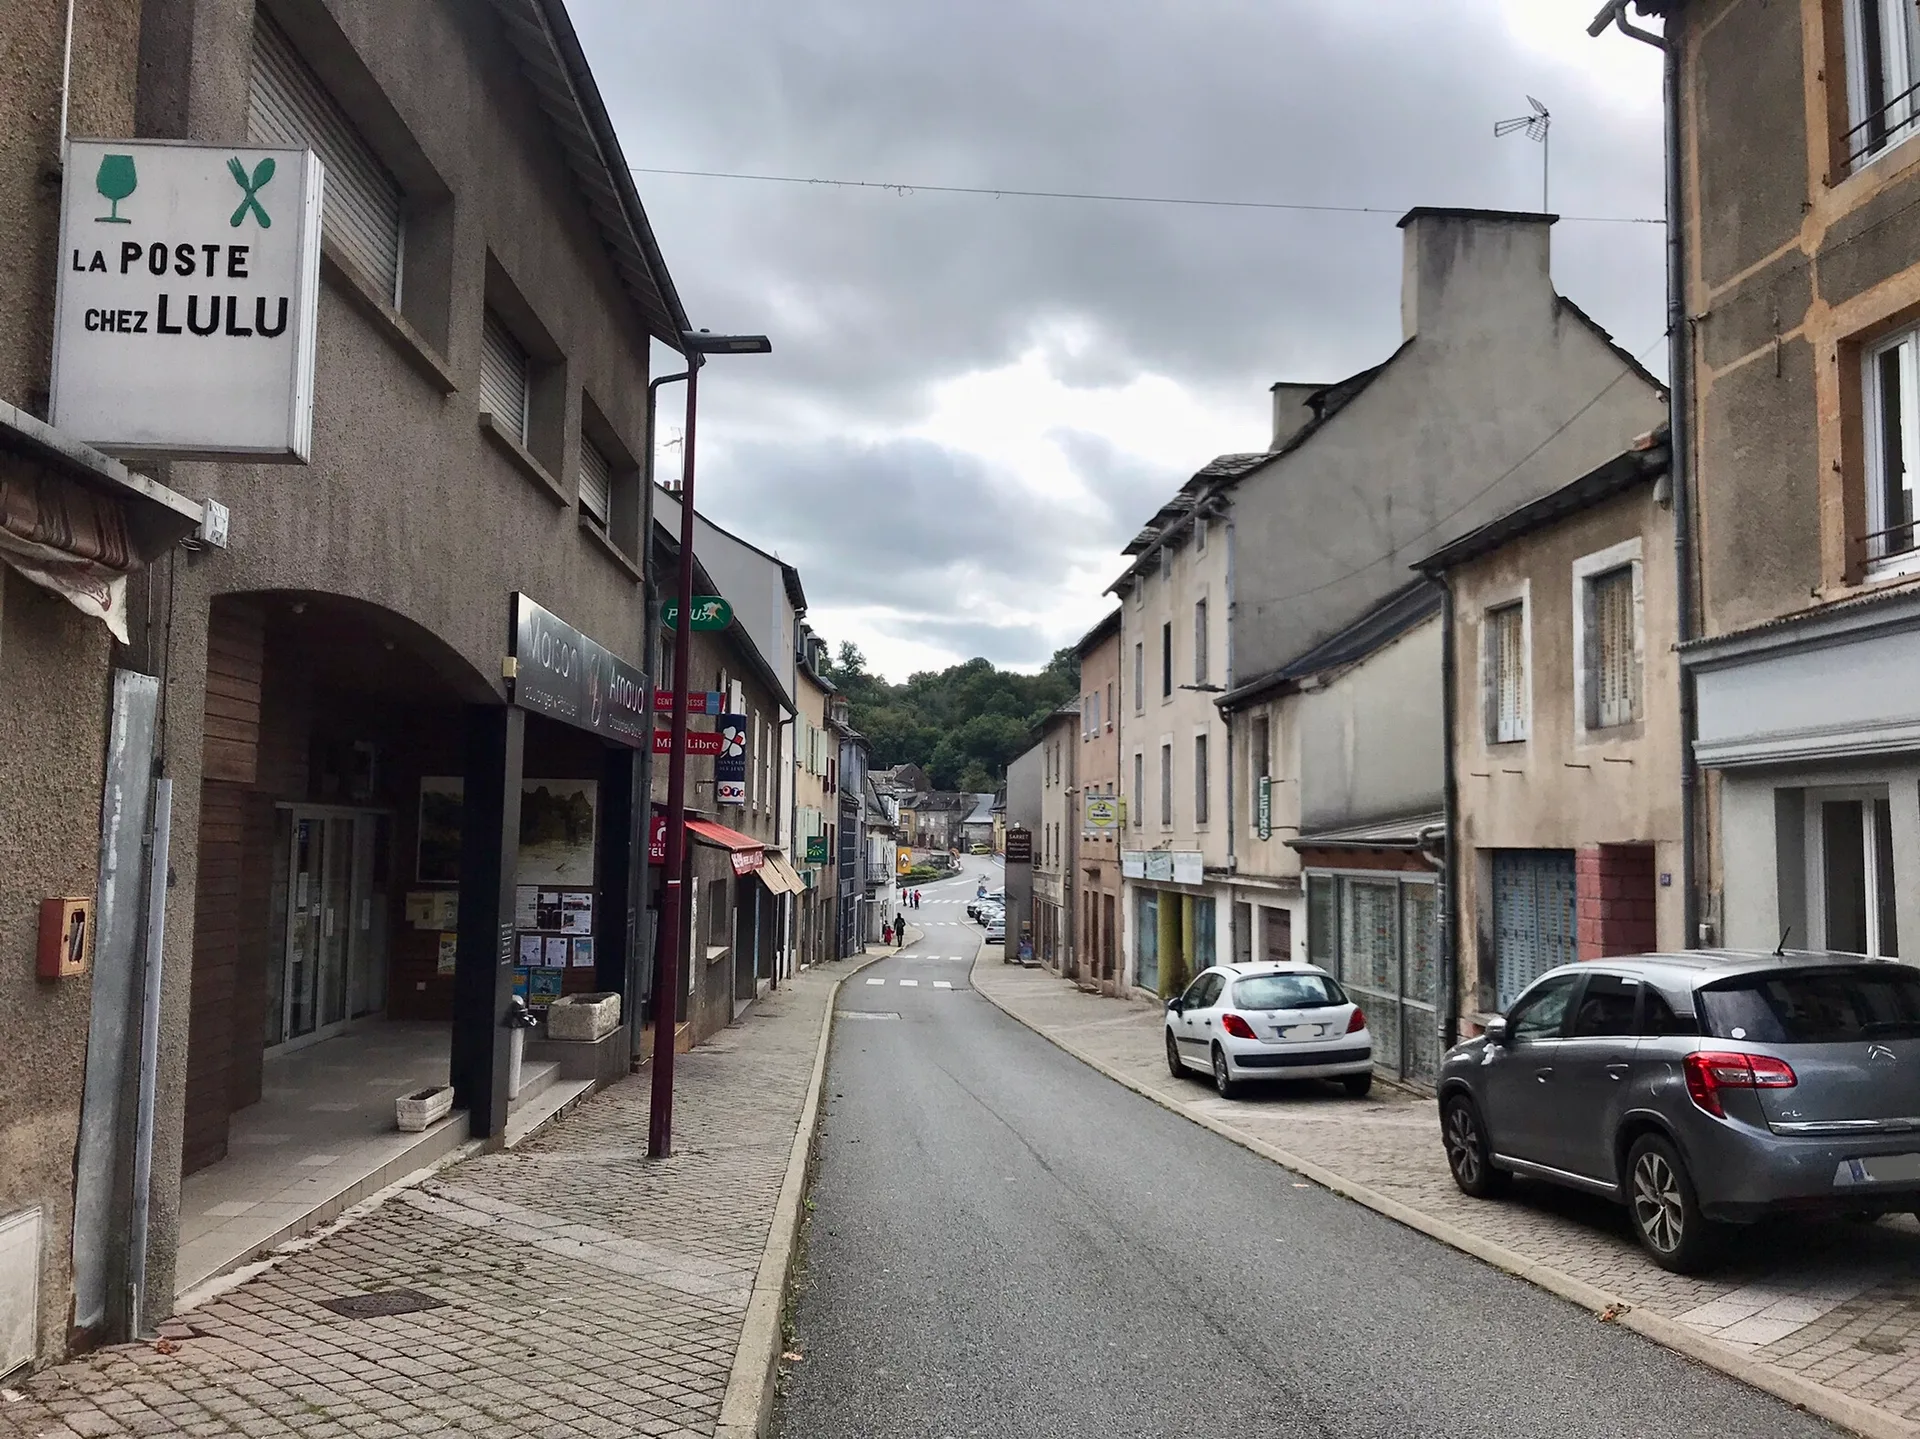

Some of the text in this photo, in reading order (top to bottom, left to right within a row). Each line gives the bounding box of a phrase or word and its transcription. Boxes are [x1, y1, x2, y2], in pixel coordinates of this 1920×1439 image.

[73, 241, 250, 278] LA POSTE
[84, 294, 289, 338] CHEZ LULU
[667, 608, 703, 621] PU
[609, 665, 645, 715] Arnaud
[656, 737, 719, 751] Mi Libre
[1259, 776, 1269, 840] FLEURS
